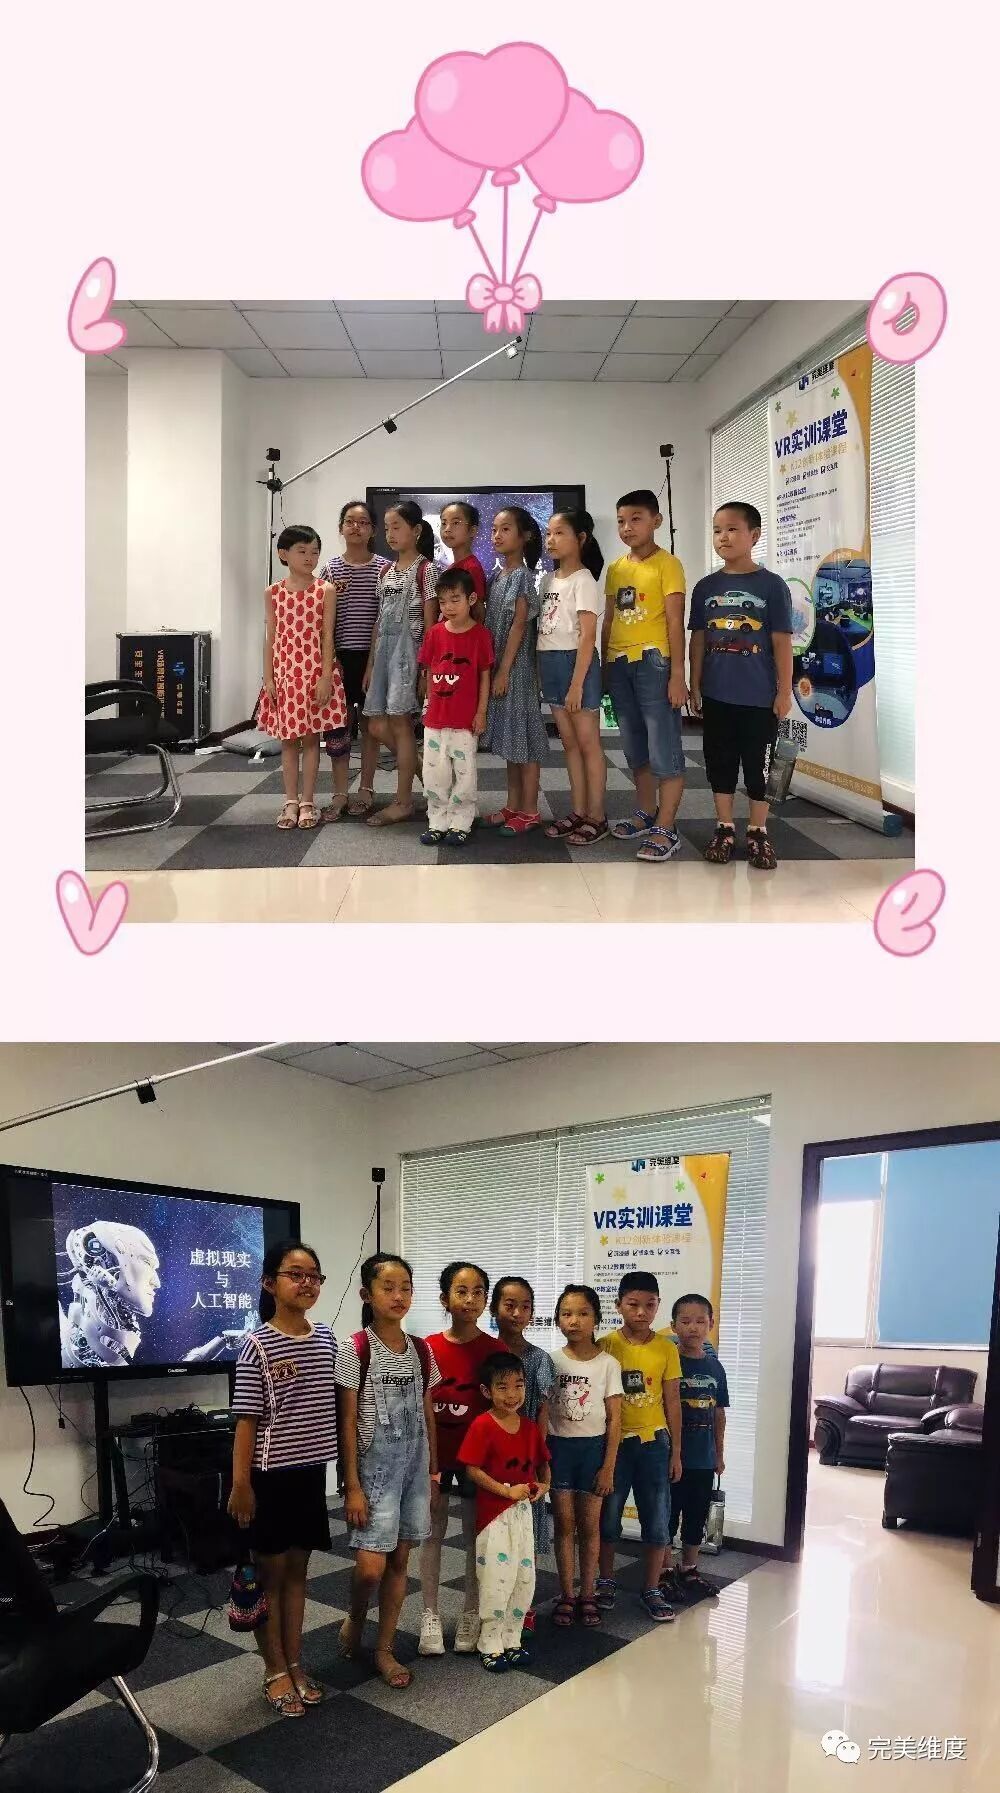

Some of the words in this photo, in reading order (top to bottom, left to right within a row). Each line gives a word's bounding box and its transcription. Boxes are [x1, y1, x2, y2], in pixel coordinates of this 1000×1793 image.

[774, 408, 848, 458] VR实训课堂
[593, 1202, 693, 1230] VR实训课堂
[189, 1248, 252, 1269] 虚拟现实
[215, 1273, 230, 1287] 与
[190, 1291, 253, 1310] 人工智能
